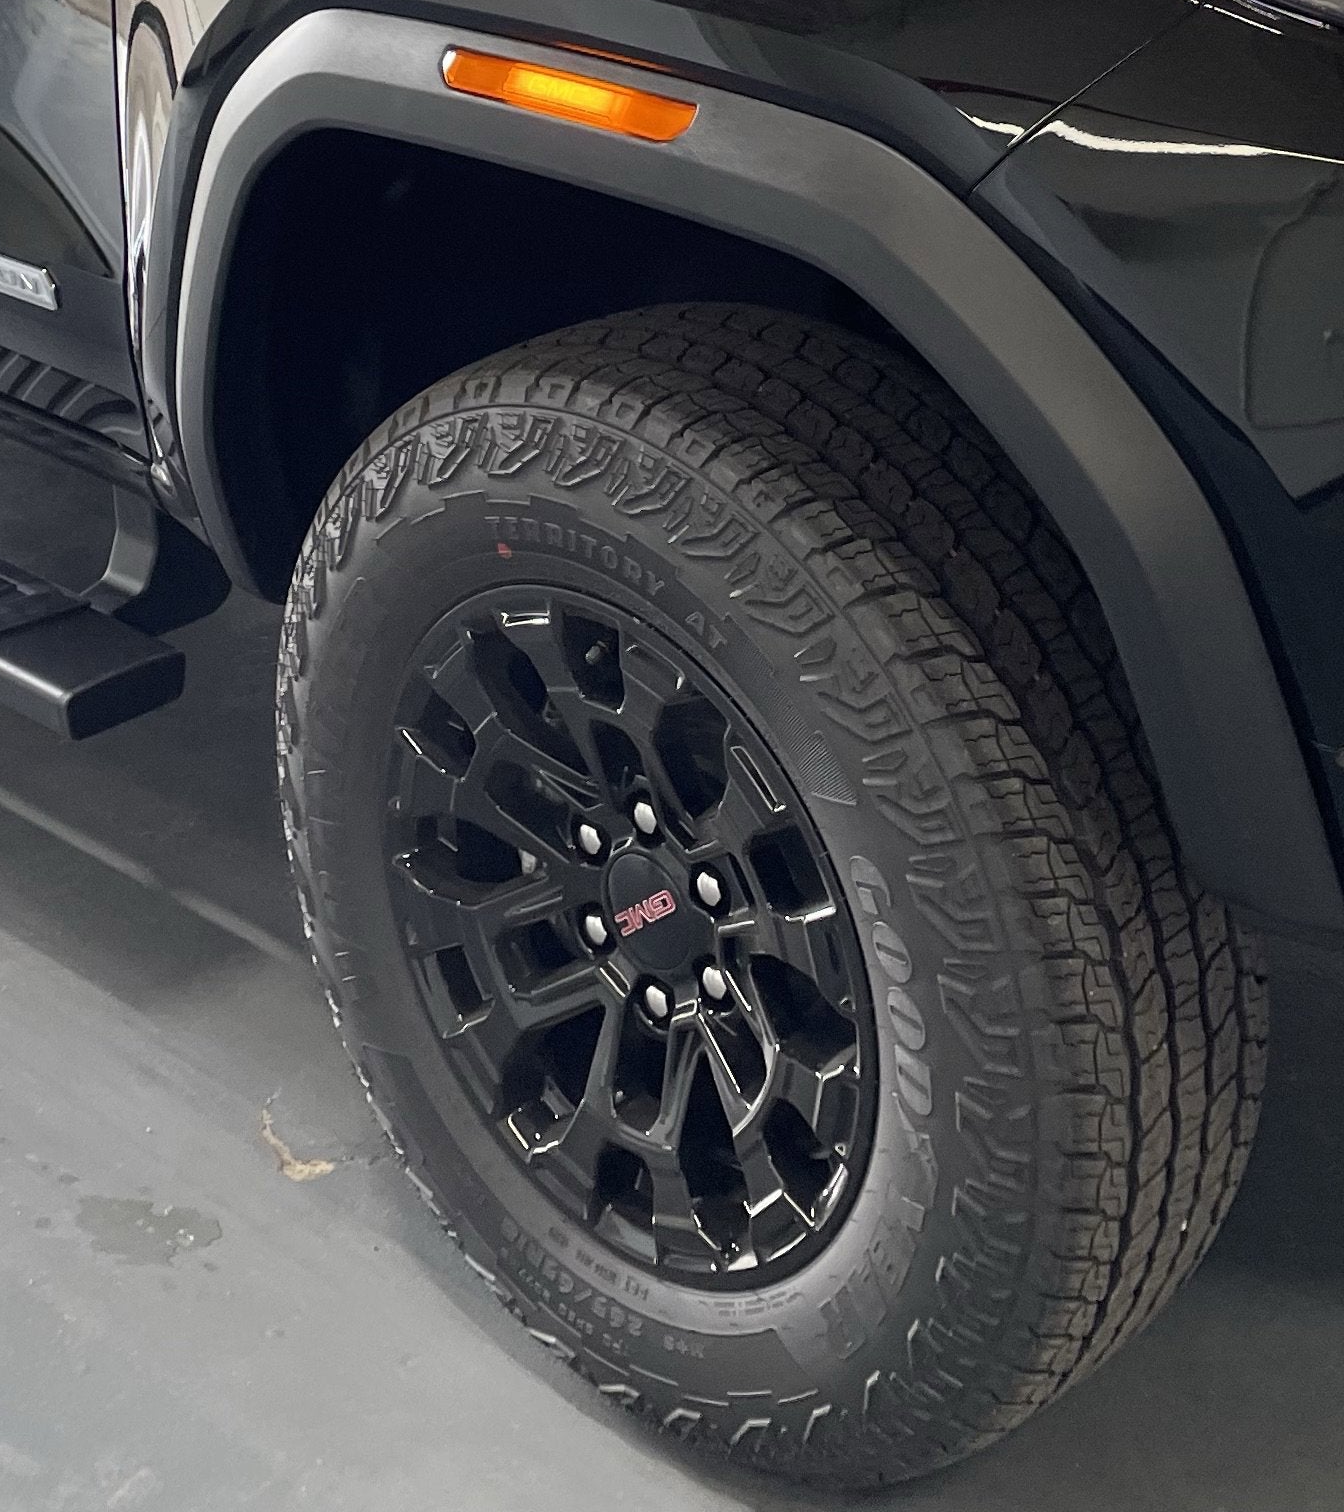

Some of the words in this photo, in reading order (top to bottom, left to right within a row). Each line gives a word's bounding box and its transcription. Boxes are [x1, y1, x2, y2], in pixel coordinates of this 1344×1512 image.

[483, 515, 665, 596] TERRITORY
[684, 610, 728, 649] AT
[613, 889, 676, 937] GMC
